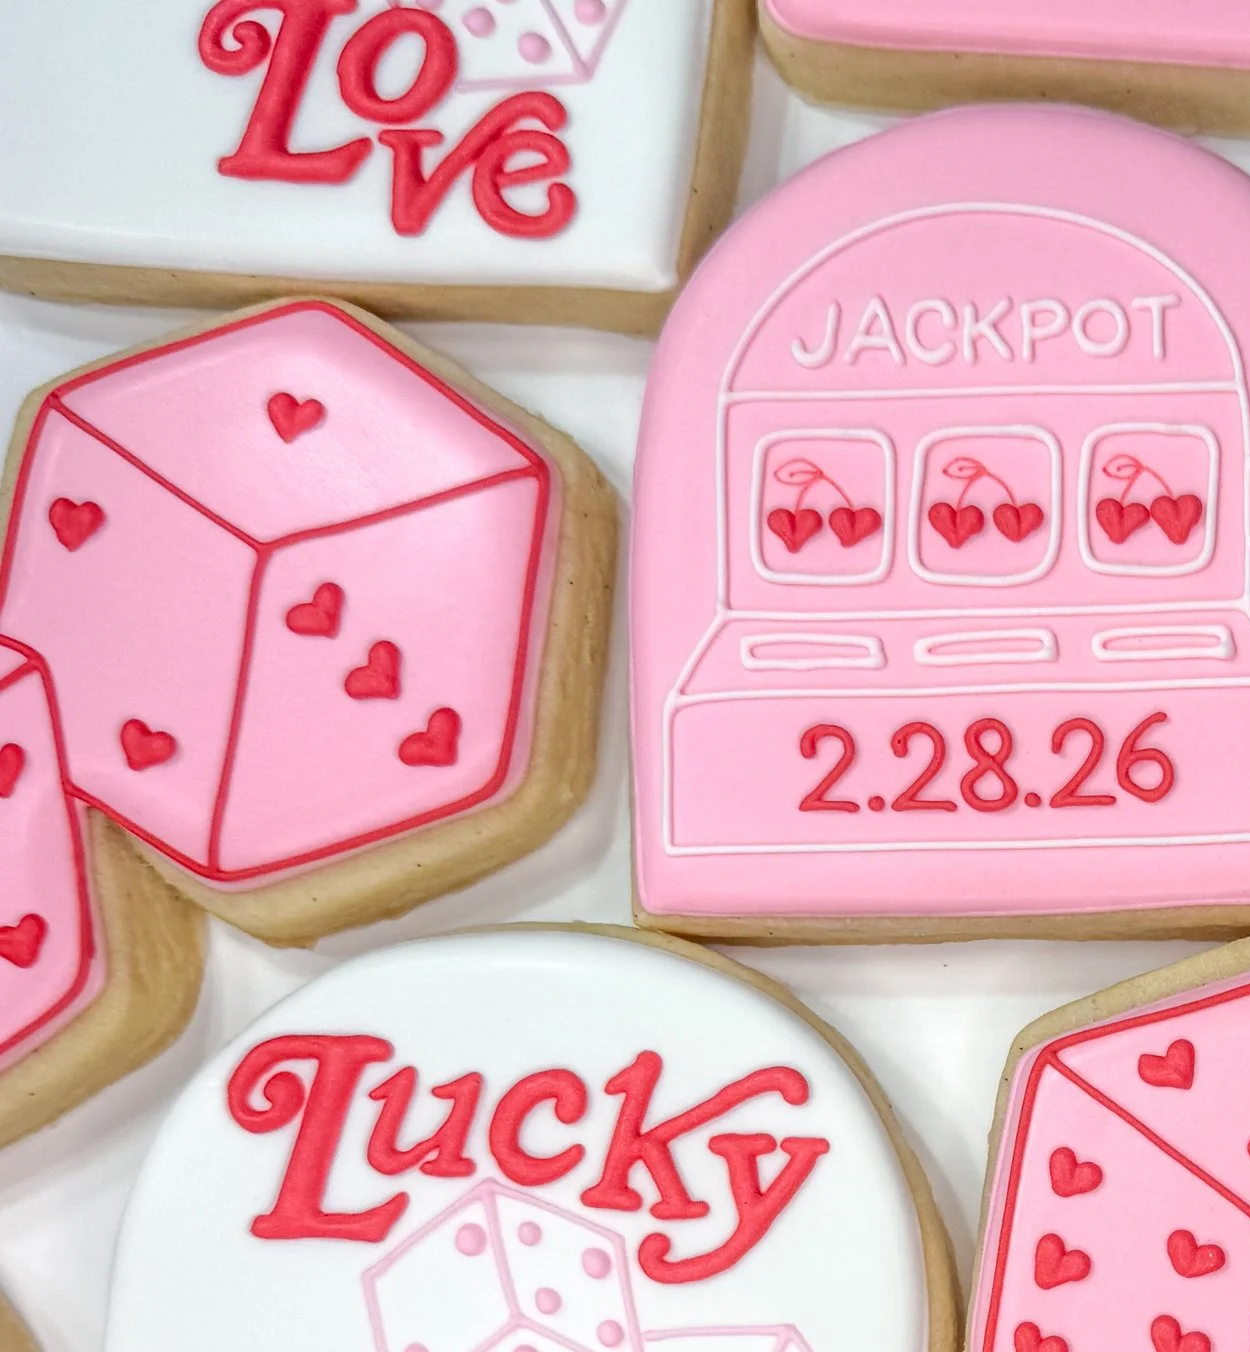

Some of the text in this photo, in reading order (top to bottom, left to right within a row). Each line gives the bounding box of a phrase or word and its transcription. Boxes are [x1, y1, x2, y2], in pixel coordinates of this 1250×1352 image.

[197, 0, 577, 238] Love
[791, 294, 1181, 369] JACKPOT
[798, 711, 1176, 814] 2.28.26
[226, 1034, 829, 1285] Lucky
